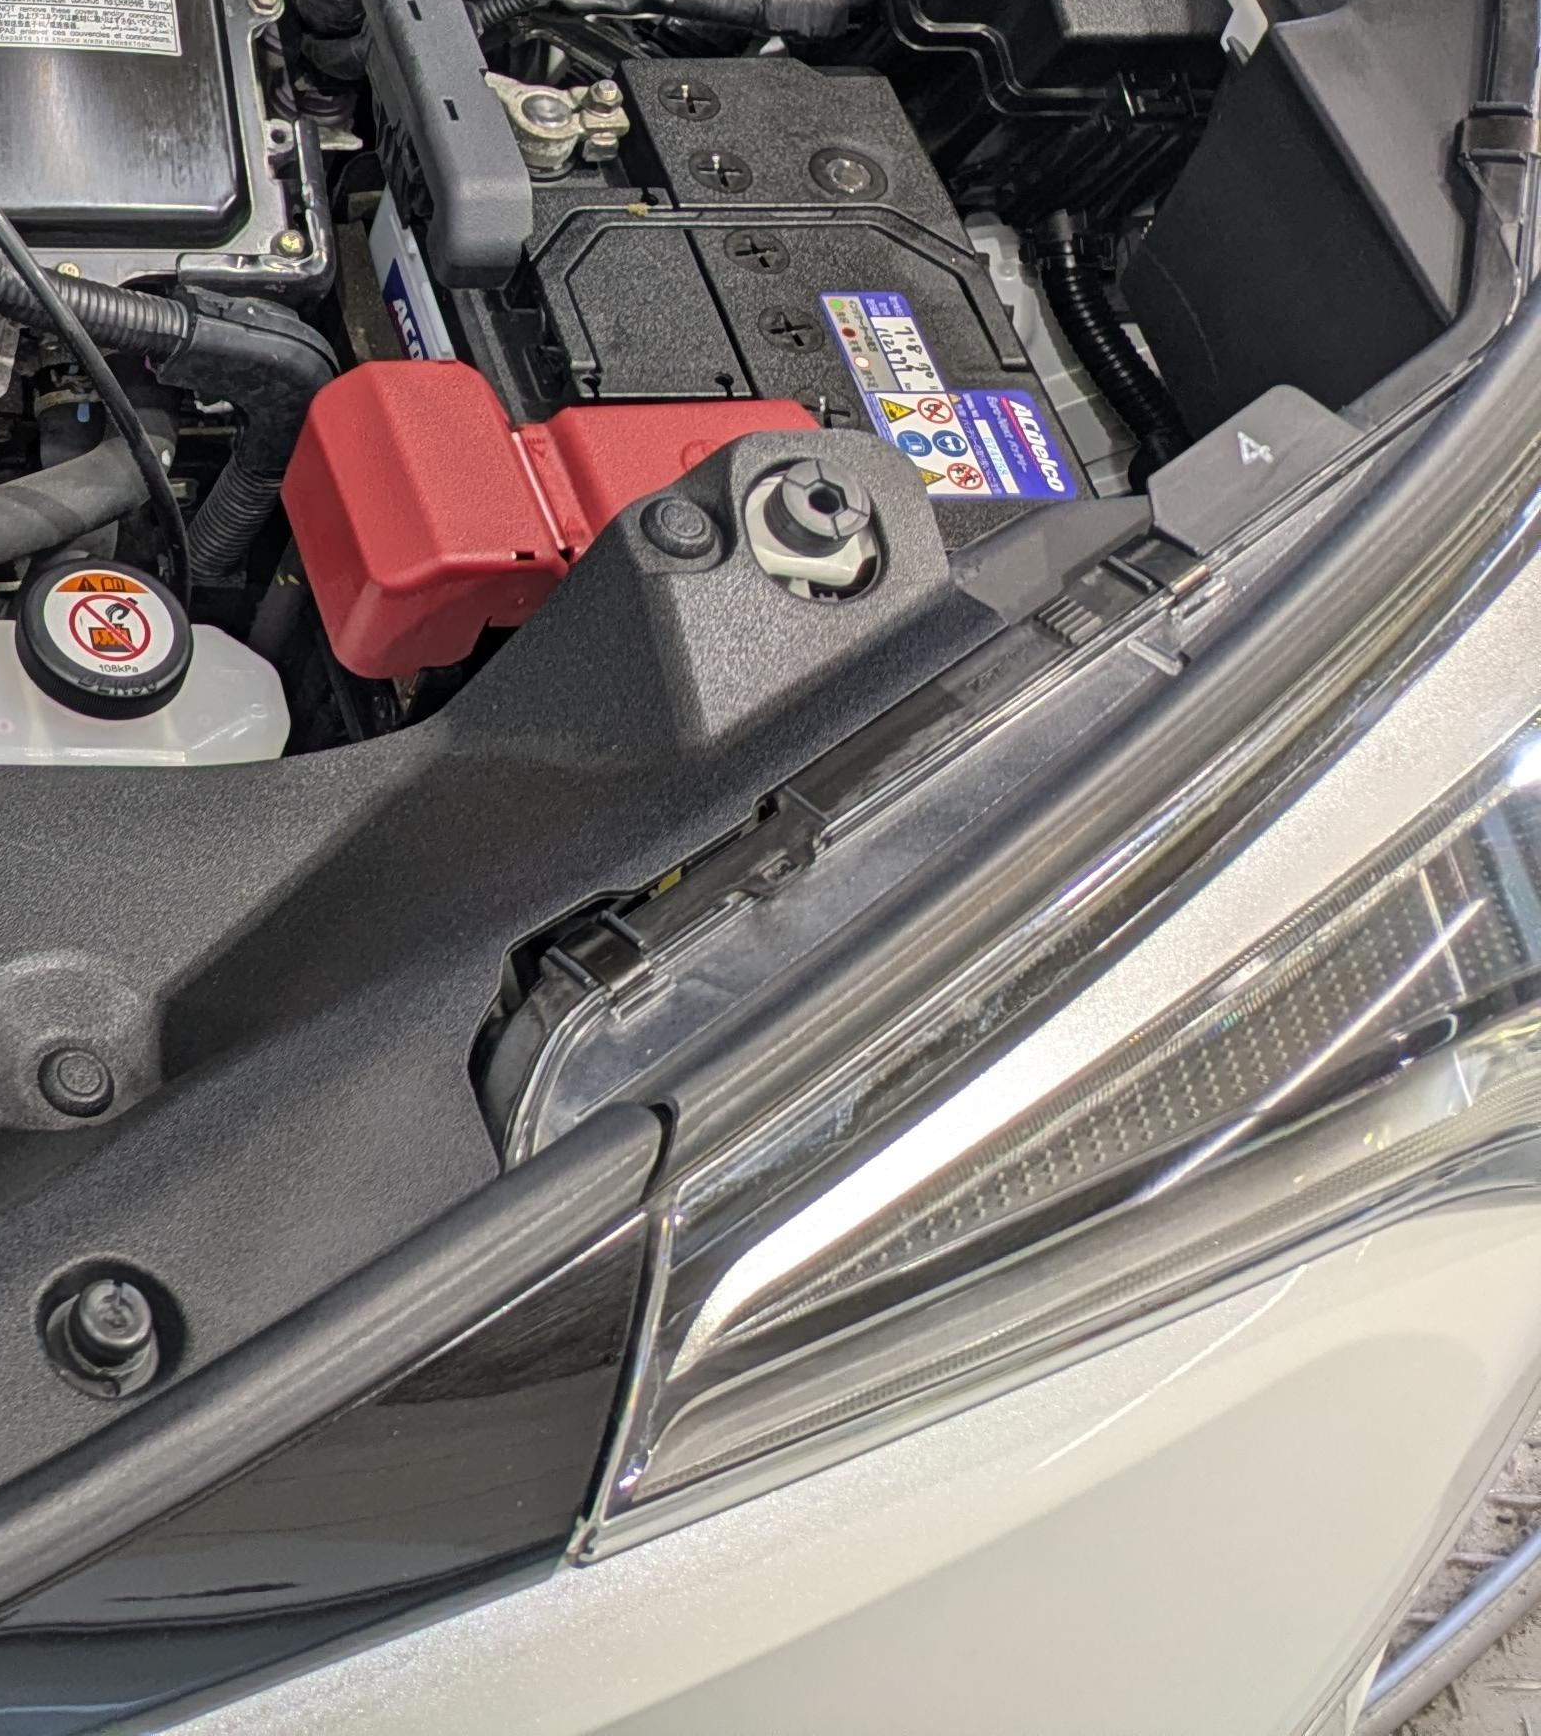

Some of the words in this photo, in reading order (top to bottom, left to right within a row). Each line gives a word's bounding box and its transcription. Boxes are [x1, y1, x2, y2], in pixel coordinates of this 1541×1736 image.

[1008, 400, 1065, 492] ACDelco
[1237, 431, 1275, 465] 4
[99, 664, 139, 673] 108kPa
